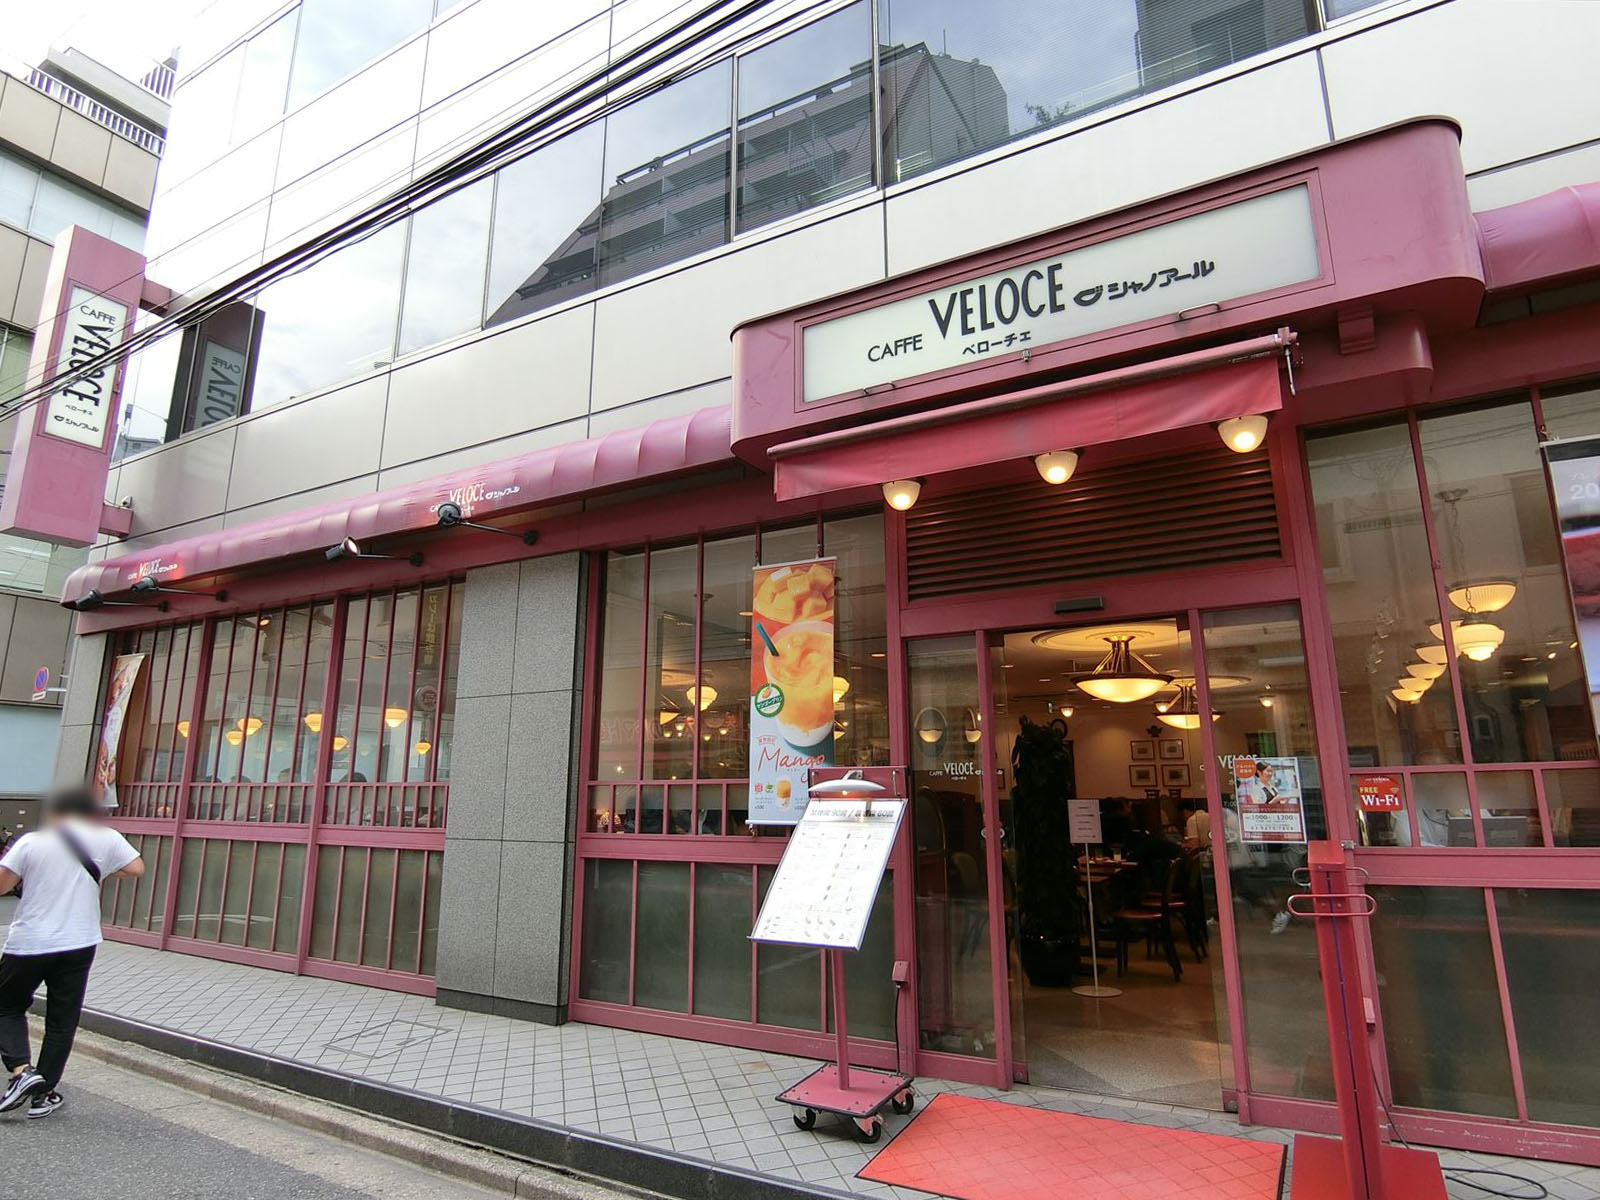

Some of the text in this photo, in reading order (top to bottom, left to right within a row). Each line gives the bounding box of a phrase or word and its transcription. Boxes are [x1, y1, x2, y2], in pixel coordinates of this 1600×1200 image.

[1107, 260, 1215, 300] シャノアール
[80, 305, 116, 325] CAFFE
[868, 263, 1065, 362] CAFFE VELOCE
[962, 331, 1032, 355] ベローチェ
[449, 482, 487, 505] VELOCE
[758, 746, 826, 783] Mango
[943, 762, 974, 775] VELOCE
[1361, 794, 1399, 806] Wi-Fi
